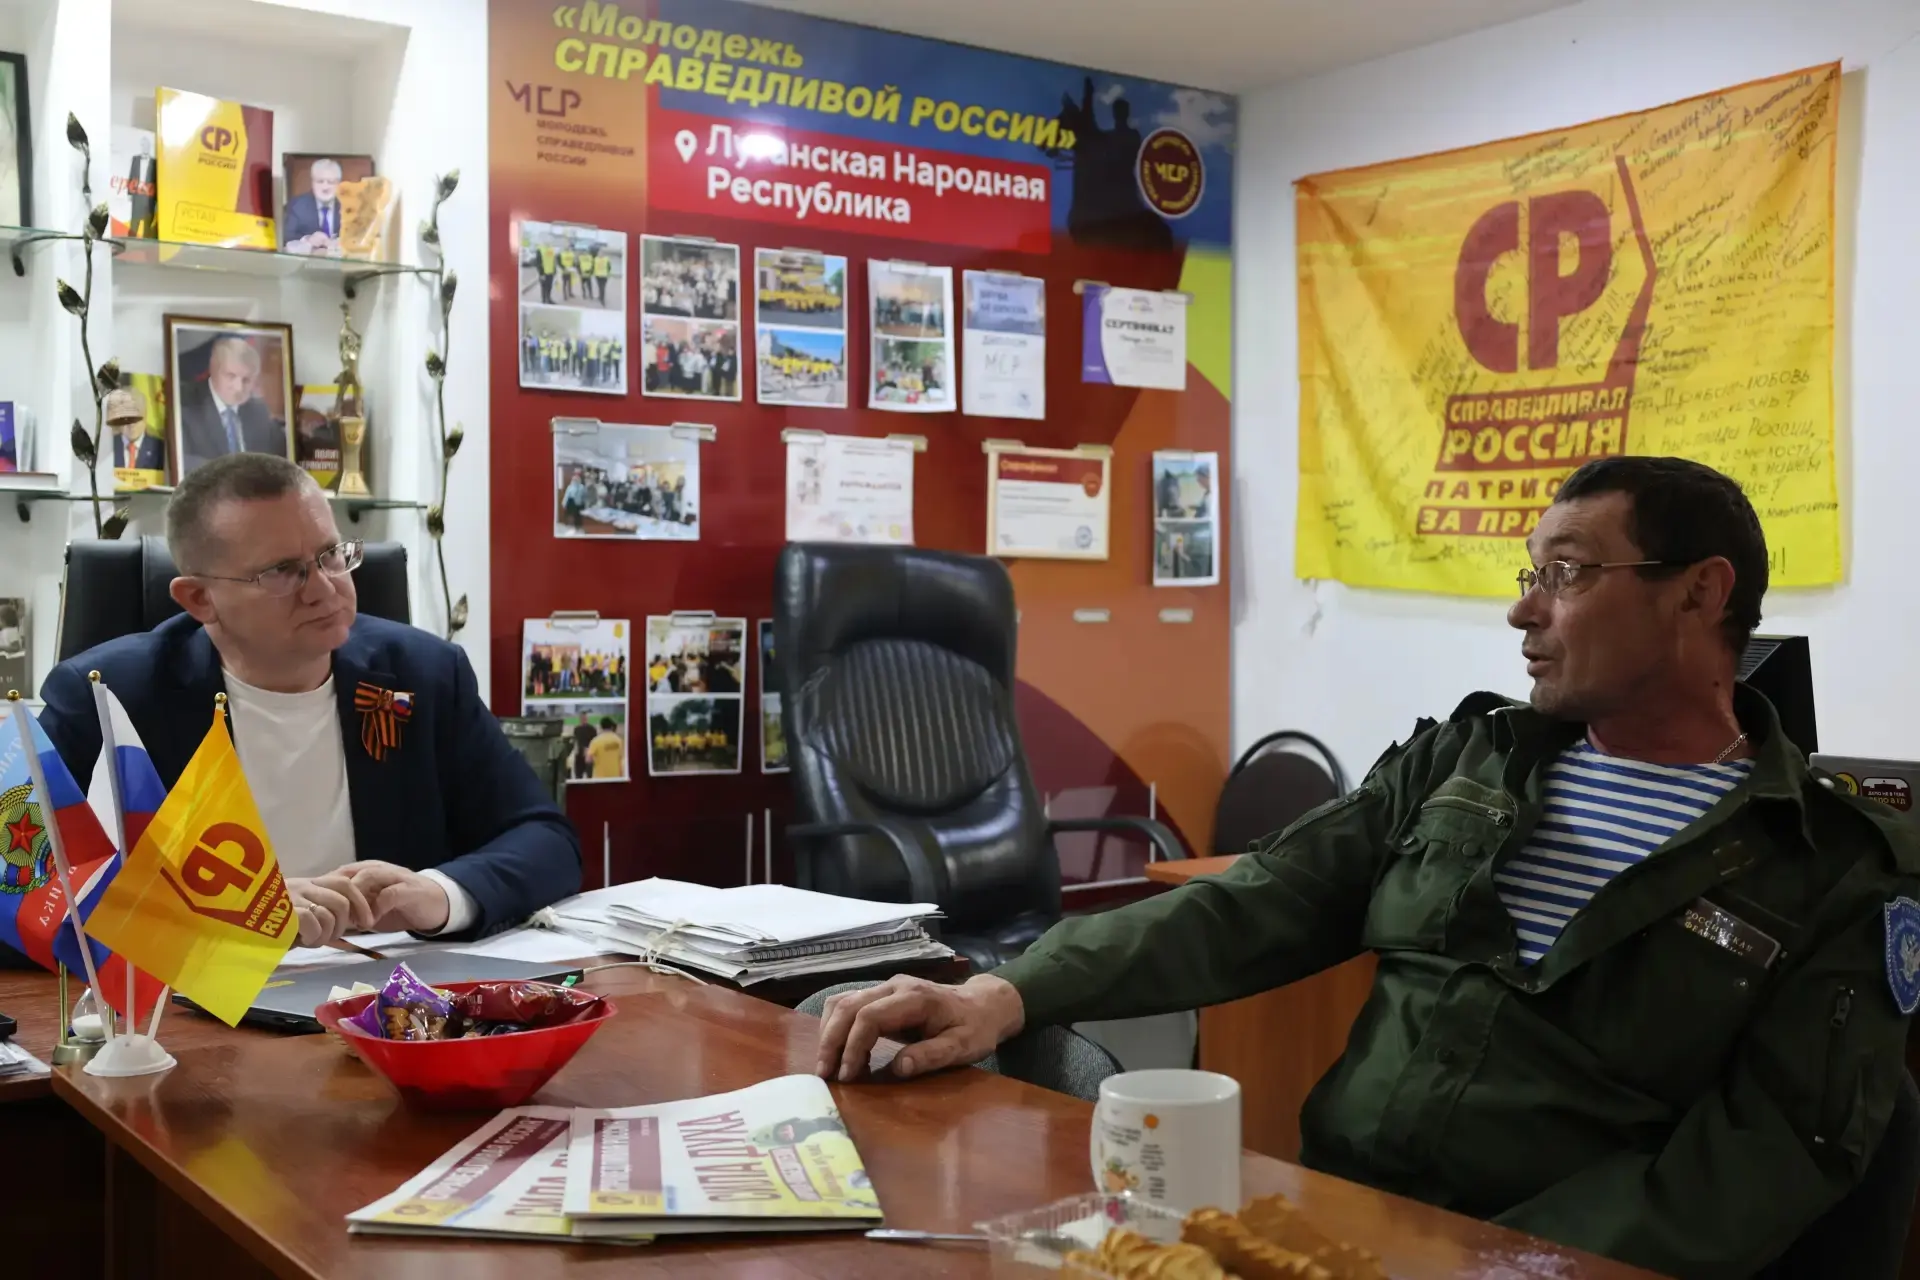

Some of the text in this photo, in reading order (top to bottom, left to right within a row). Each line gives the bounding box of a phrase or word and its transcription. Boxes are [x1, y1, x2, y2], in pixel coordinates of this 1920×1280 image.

[552, 0, 804, 68] «Молодежь
[554, 38, 1077, 149] СПРАВЕДЛИВОЙ РОССИИ»
[200, 126, 232, 152] СР
[705, 124, 1046, 201] Луанская Народная
[707, 166, 912, 223] Республика
[1453, 188, 1612, 374] СР
[1104, 318, 1175, 335] СЕРТИФИКАТ
[1449, 386, 1628, 423] СПРАВЕДЛИВАЯ
[1441, 416, 1623, 465] РОССИЯ
[1419, 509, 1462, 532] ЗА
[676, 1109, 782, 1202] СИЛА ДУХА
